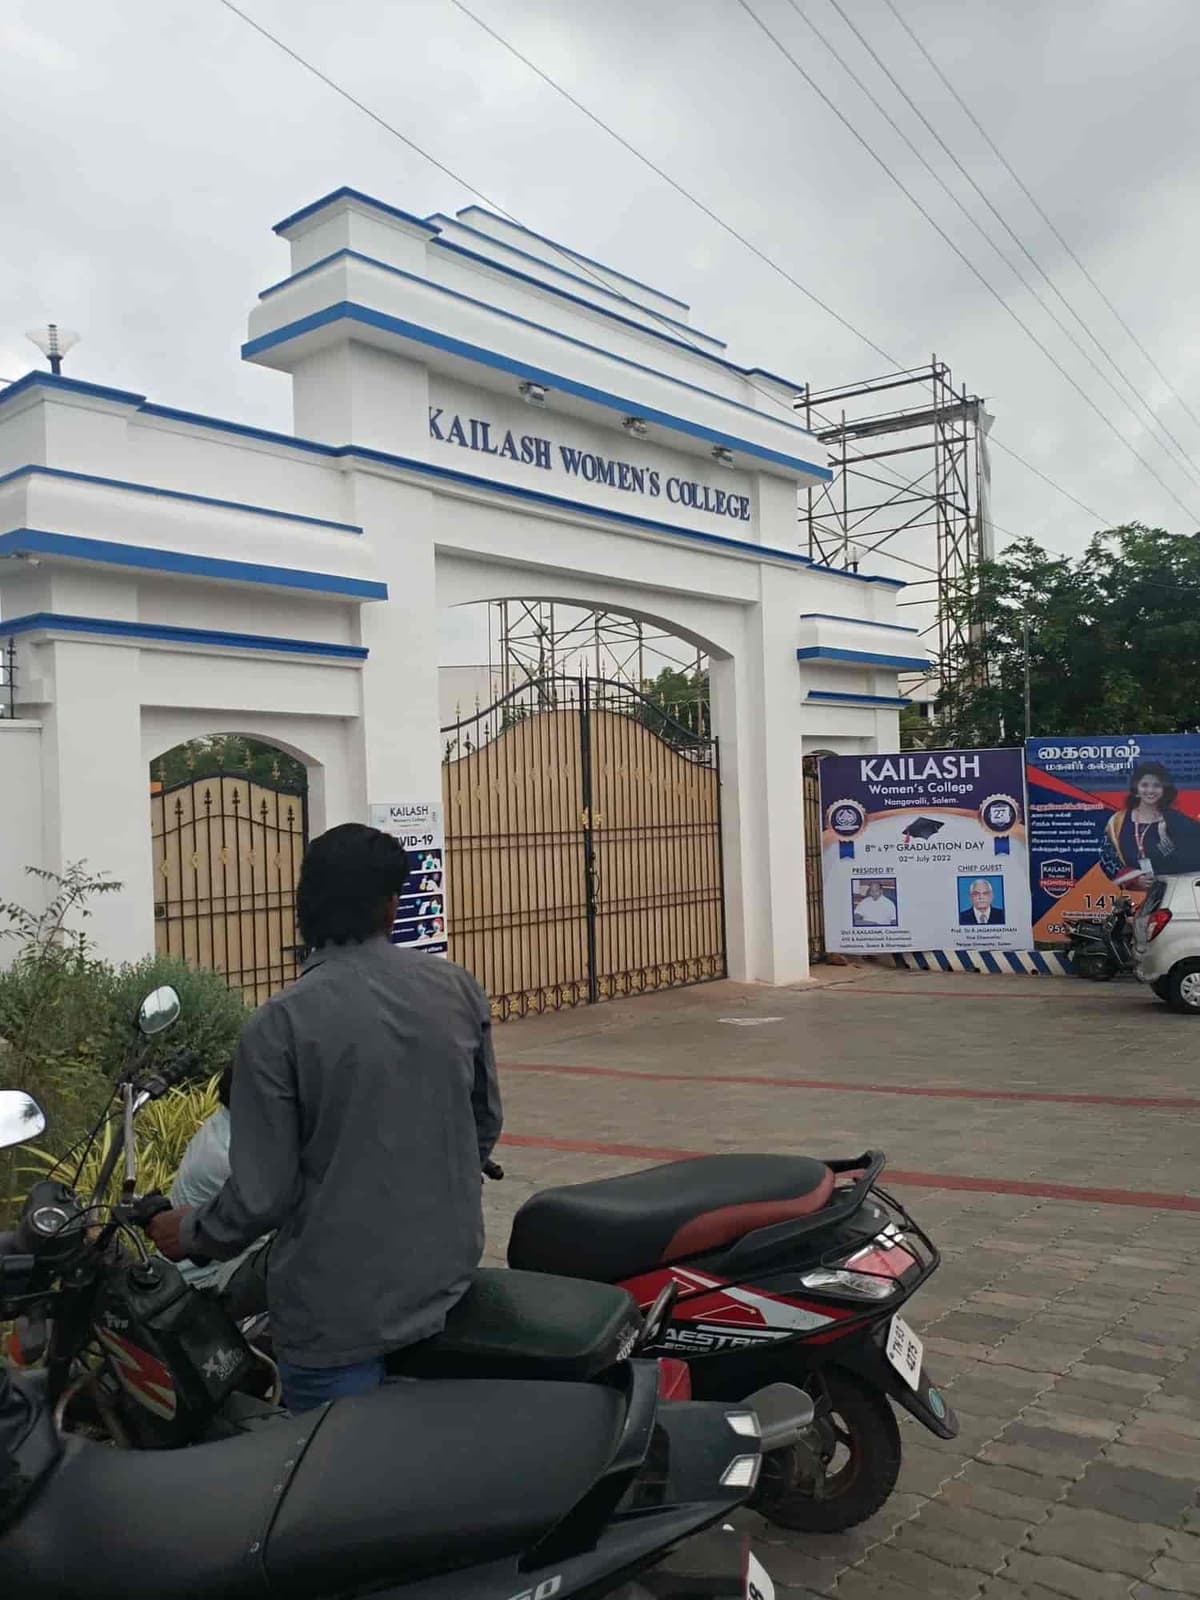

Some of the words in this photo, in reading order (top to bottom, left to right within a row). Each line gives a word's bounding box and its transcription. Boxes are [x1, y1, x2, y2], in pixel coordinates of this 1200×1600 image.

[428, 406, 553, 470] KAILASH
[559, 445, 661, 497] WOMEN'S
[666, 477, 751, 521] COLLEGE
[1038, 739, 1140, 763] கைலாஷ்
[860, 755, 980, 782] KAILASH
[869, 783, 924, 795] Women's
[927, 782, 974, 794] College
[390, 805, 429, 817] KAILASH
[399, 834, 434, 848] VID-19
[896, 842, 961, 852] GRADUATION
[965, 841, 985, 850] DAY
[916, 855, 930, 863] July
[933, 854, 952, 862] 2022
[957, 864, 978, 872] CHIEF
[979, 864, 1003, 872] GUEST
